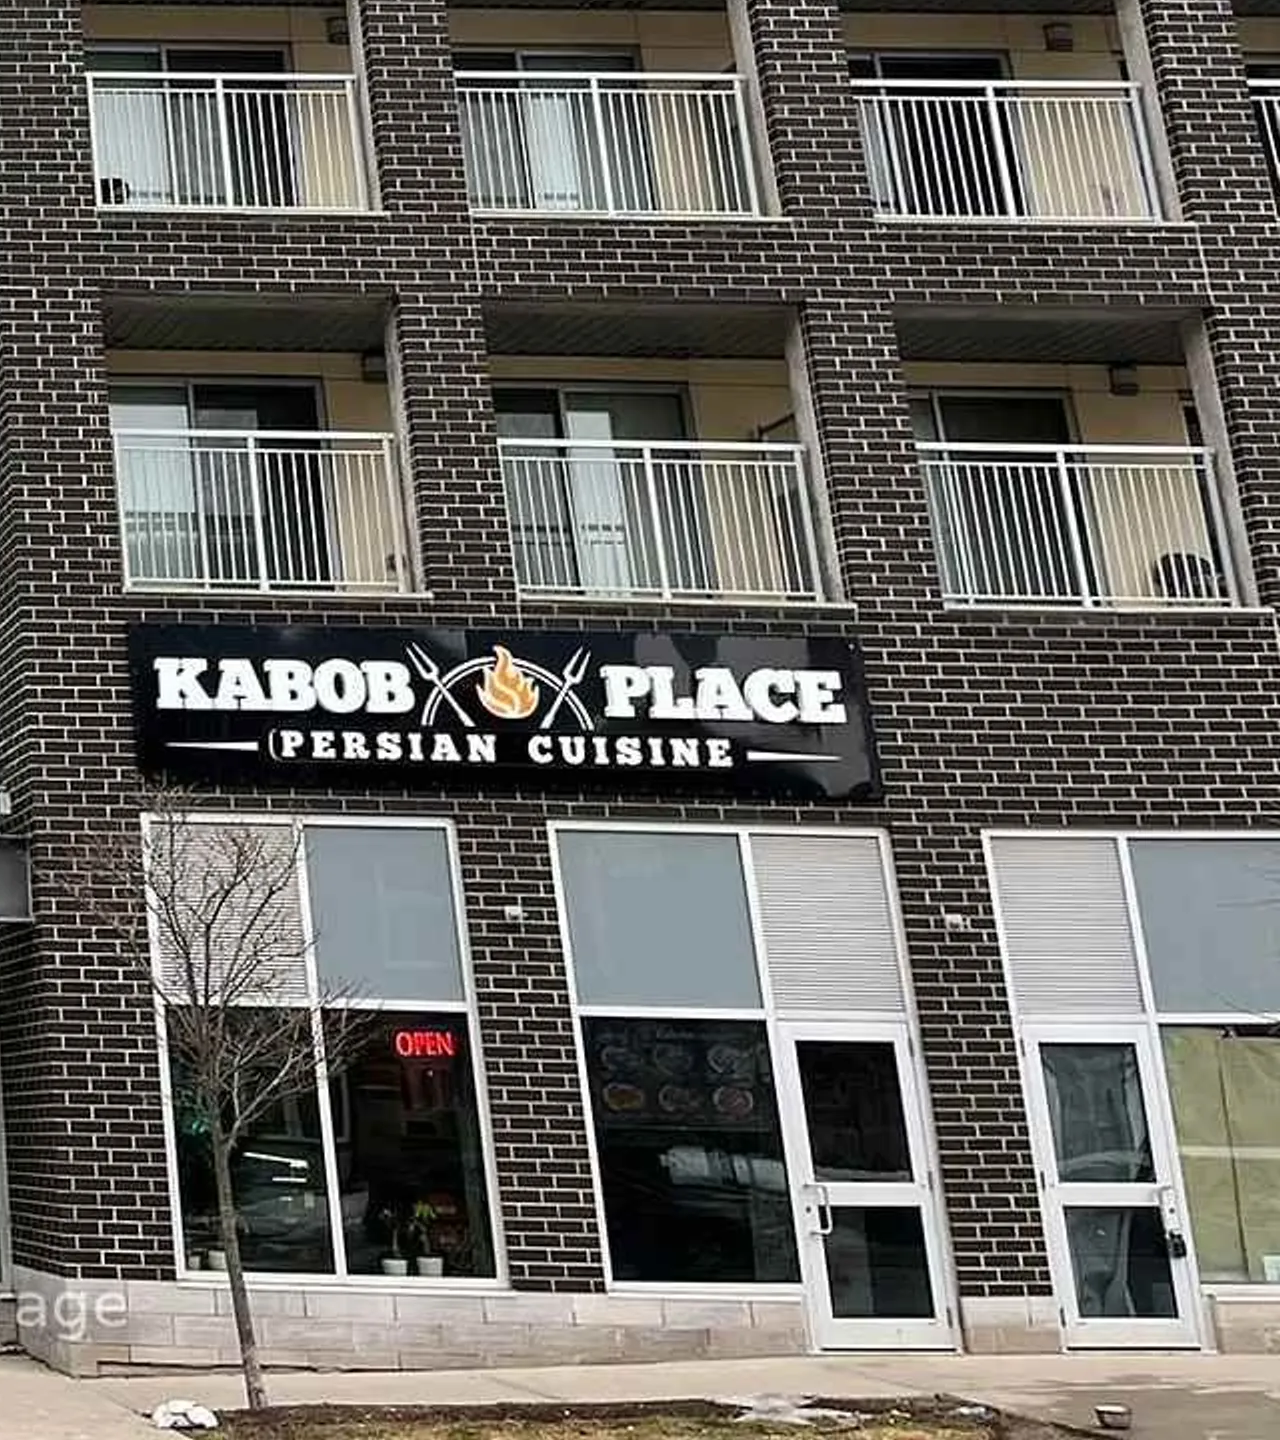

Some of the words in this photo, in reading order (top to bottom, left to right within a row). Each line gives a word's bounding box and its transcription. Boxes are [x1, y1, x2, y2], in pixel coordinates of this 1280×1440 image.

[154, 657, 416, 715] KABOB
[599, 664, 847, 725] PLACE
[281, 732, 496, 763] PERSIAN
[527, 735, 734, 768] CUISINE
[395, 1030, 455, 1057] OPEN
